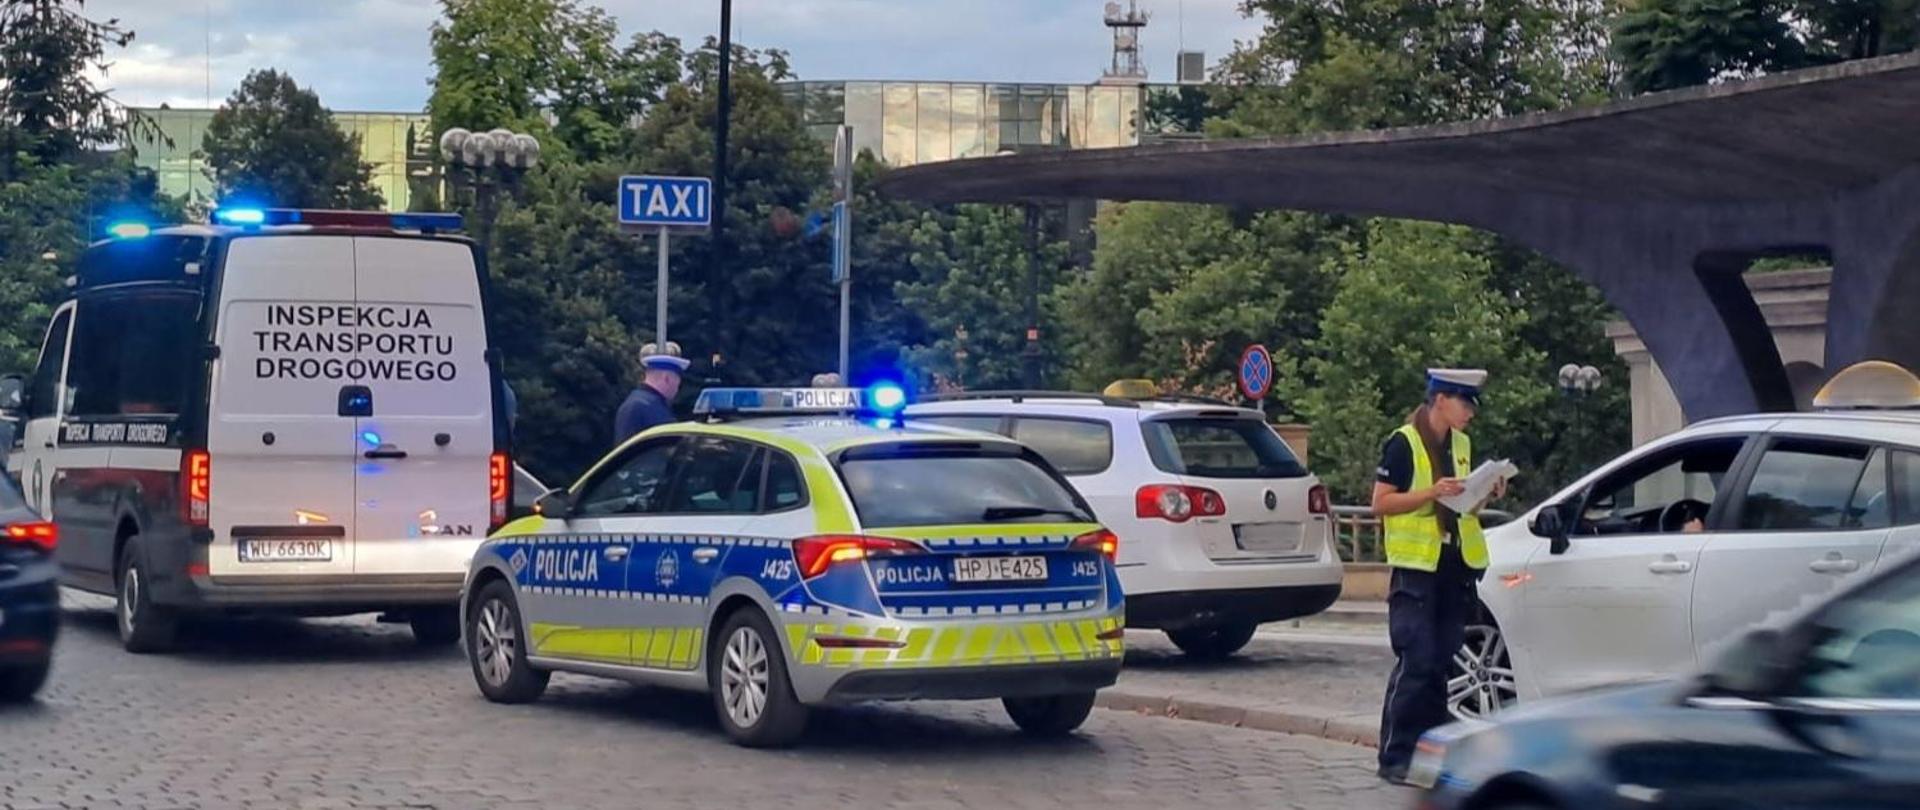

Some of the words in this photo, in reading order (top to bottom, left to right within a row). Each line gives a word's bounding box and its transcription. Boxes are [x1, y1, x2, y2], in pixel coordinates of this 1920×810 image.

[626, 183, 704, 218] TAXI
[267, 305, 432, 328] INSPEKCJA
[254, 332, 453, 355] TRANSPORTU
[256, 358, 456, 381] DROGOWEGO
[796, 390, 856, 407] POLICJA
[250, 541, 270, 556] WU
[278, 541, 325, 557] 6630K
[535, 548, 598, 581] POLICJA
[760, 559, 792, 580] J425
[876, 565, 944, 584] POLICJA
[1072, 561, 1098, 577] J425
